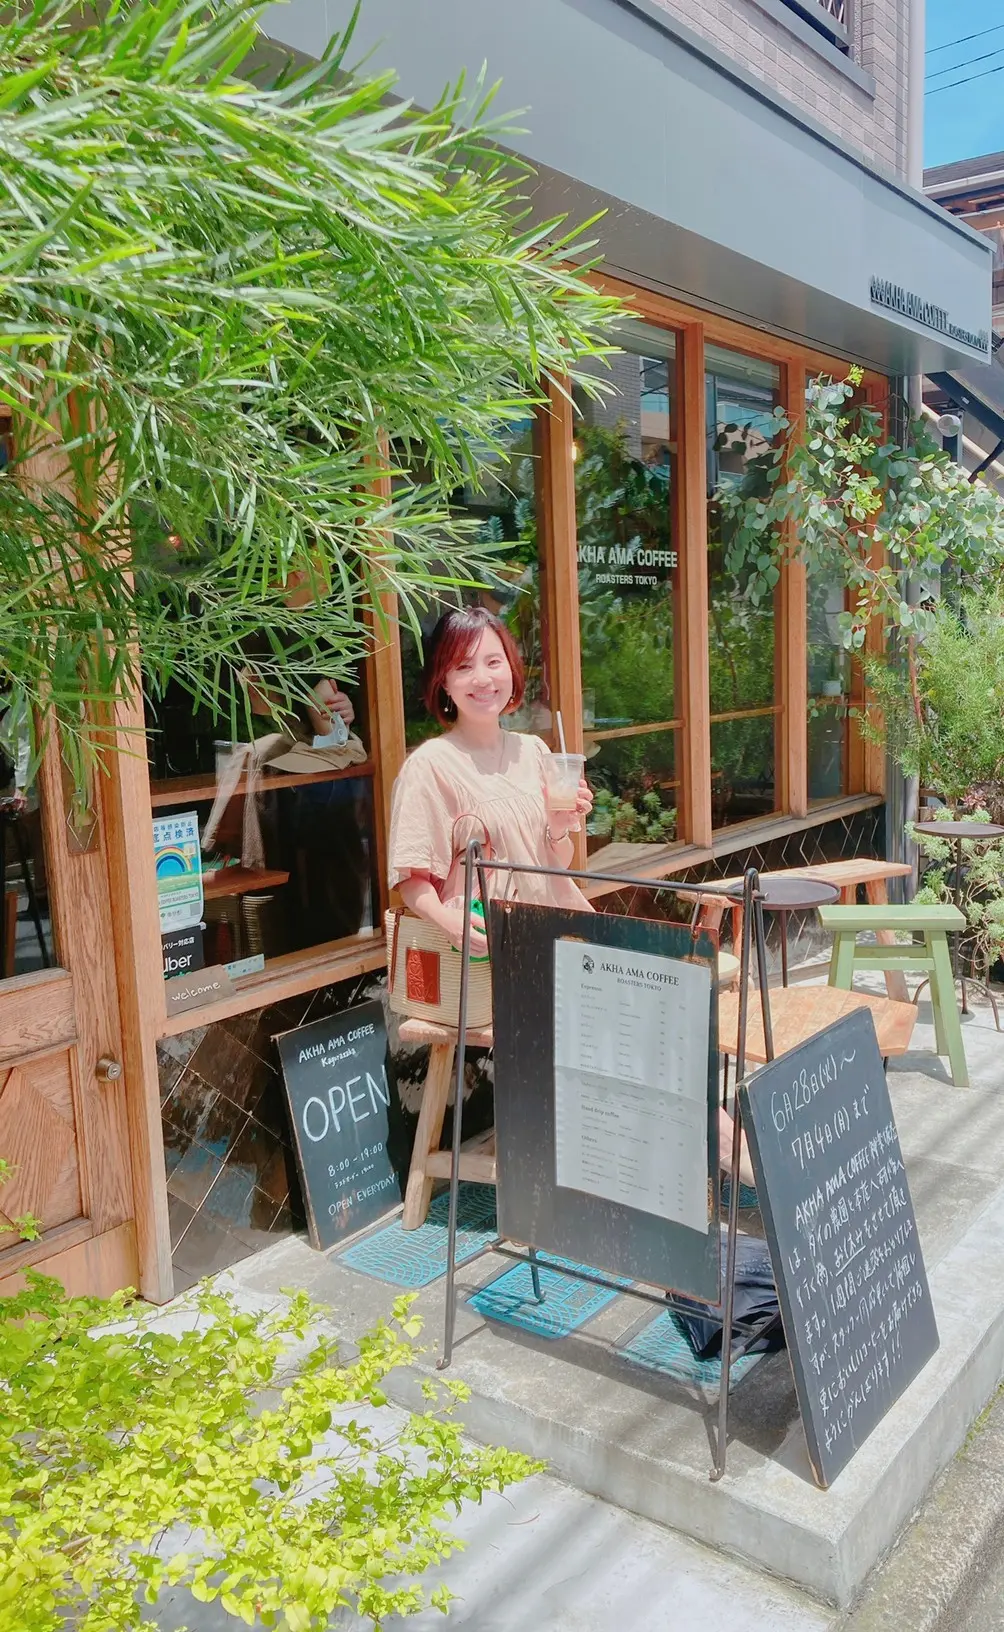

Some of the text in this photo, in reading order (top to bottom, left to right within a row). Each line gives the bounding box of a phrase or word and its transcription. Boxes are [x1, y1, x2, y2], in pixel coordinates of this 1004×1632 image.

[608, 547, 634, 565] AMA
[637, 549, 677, 568] COFFEE
[595, 574, 657, 585] ROASTERS TOKYO
[600, 963, 679, 987] AKHA AMA COFFEE
[172, 982, 220, 1001] welcome
[298, 1023, 374, 1063] AKHA AMA COFFEE
[302, 1064, 391, 1141] OPEN
[328, 1158, 349, 1177] 8:00
[360, 1142, 383, 1161] 19:00
[328, 1195, 353, 1216] OPEN
[794, 1186, 824, 1231] AKHA
[825, 1165, 847, 1202] AMA
